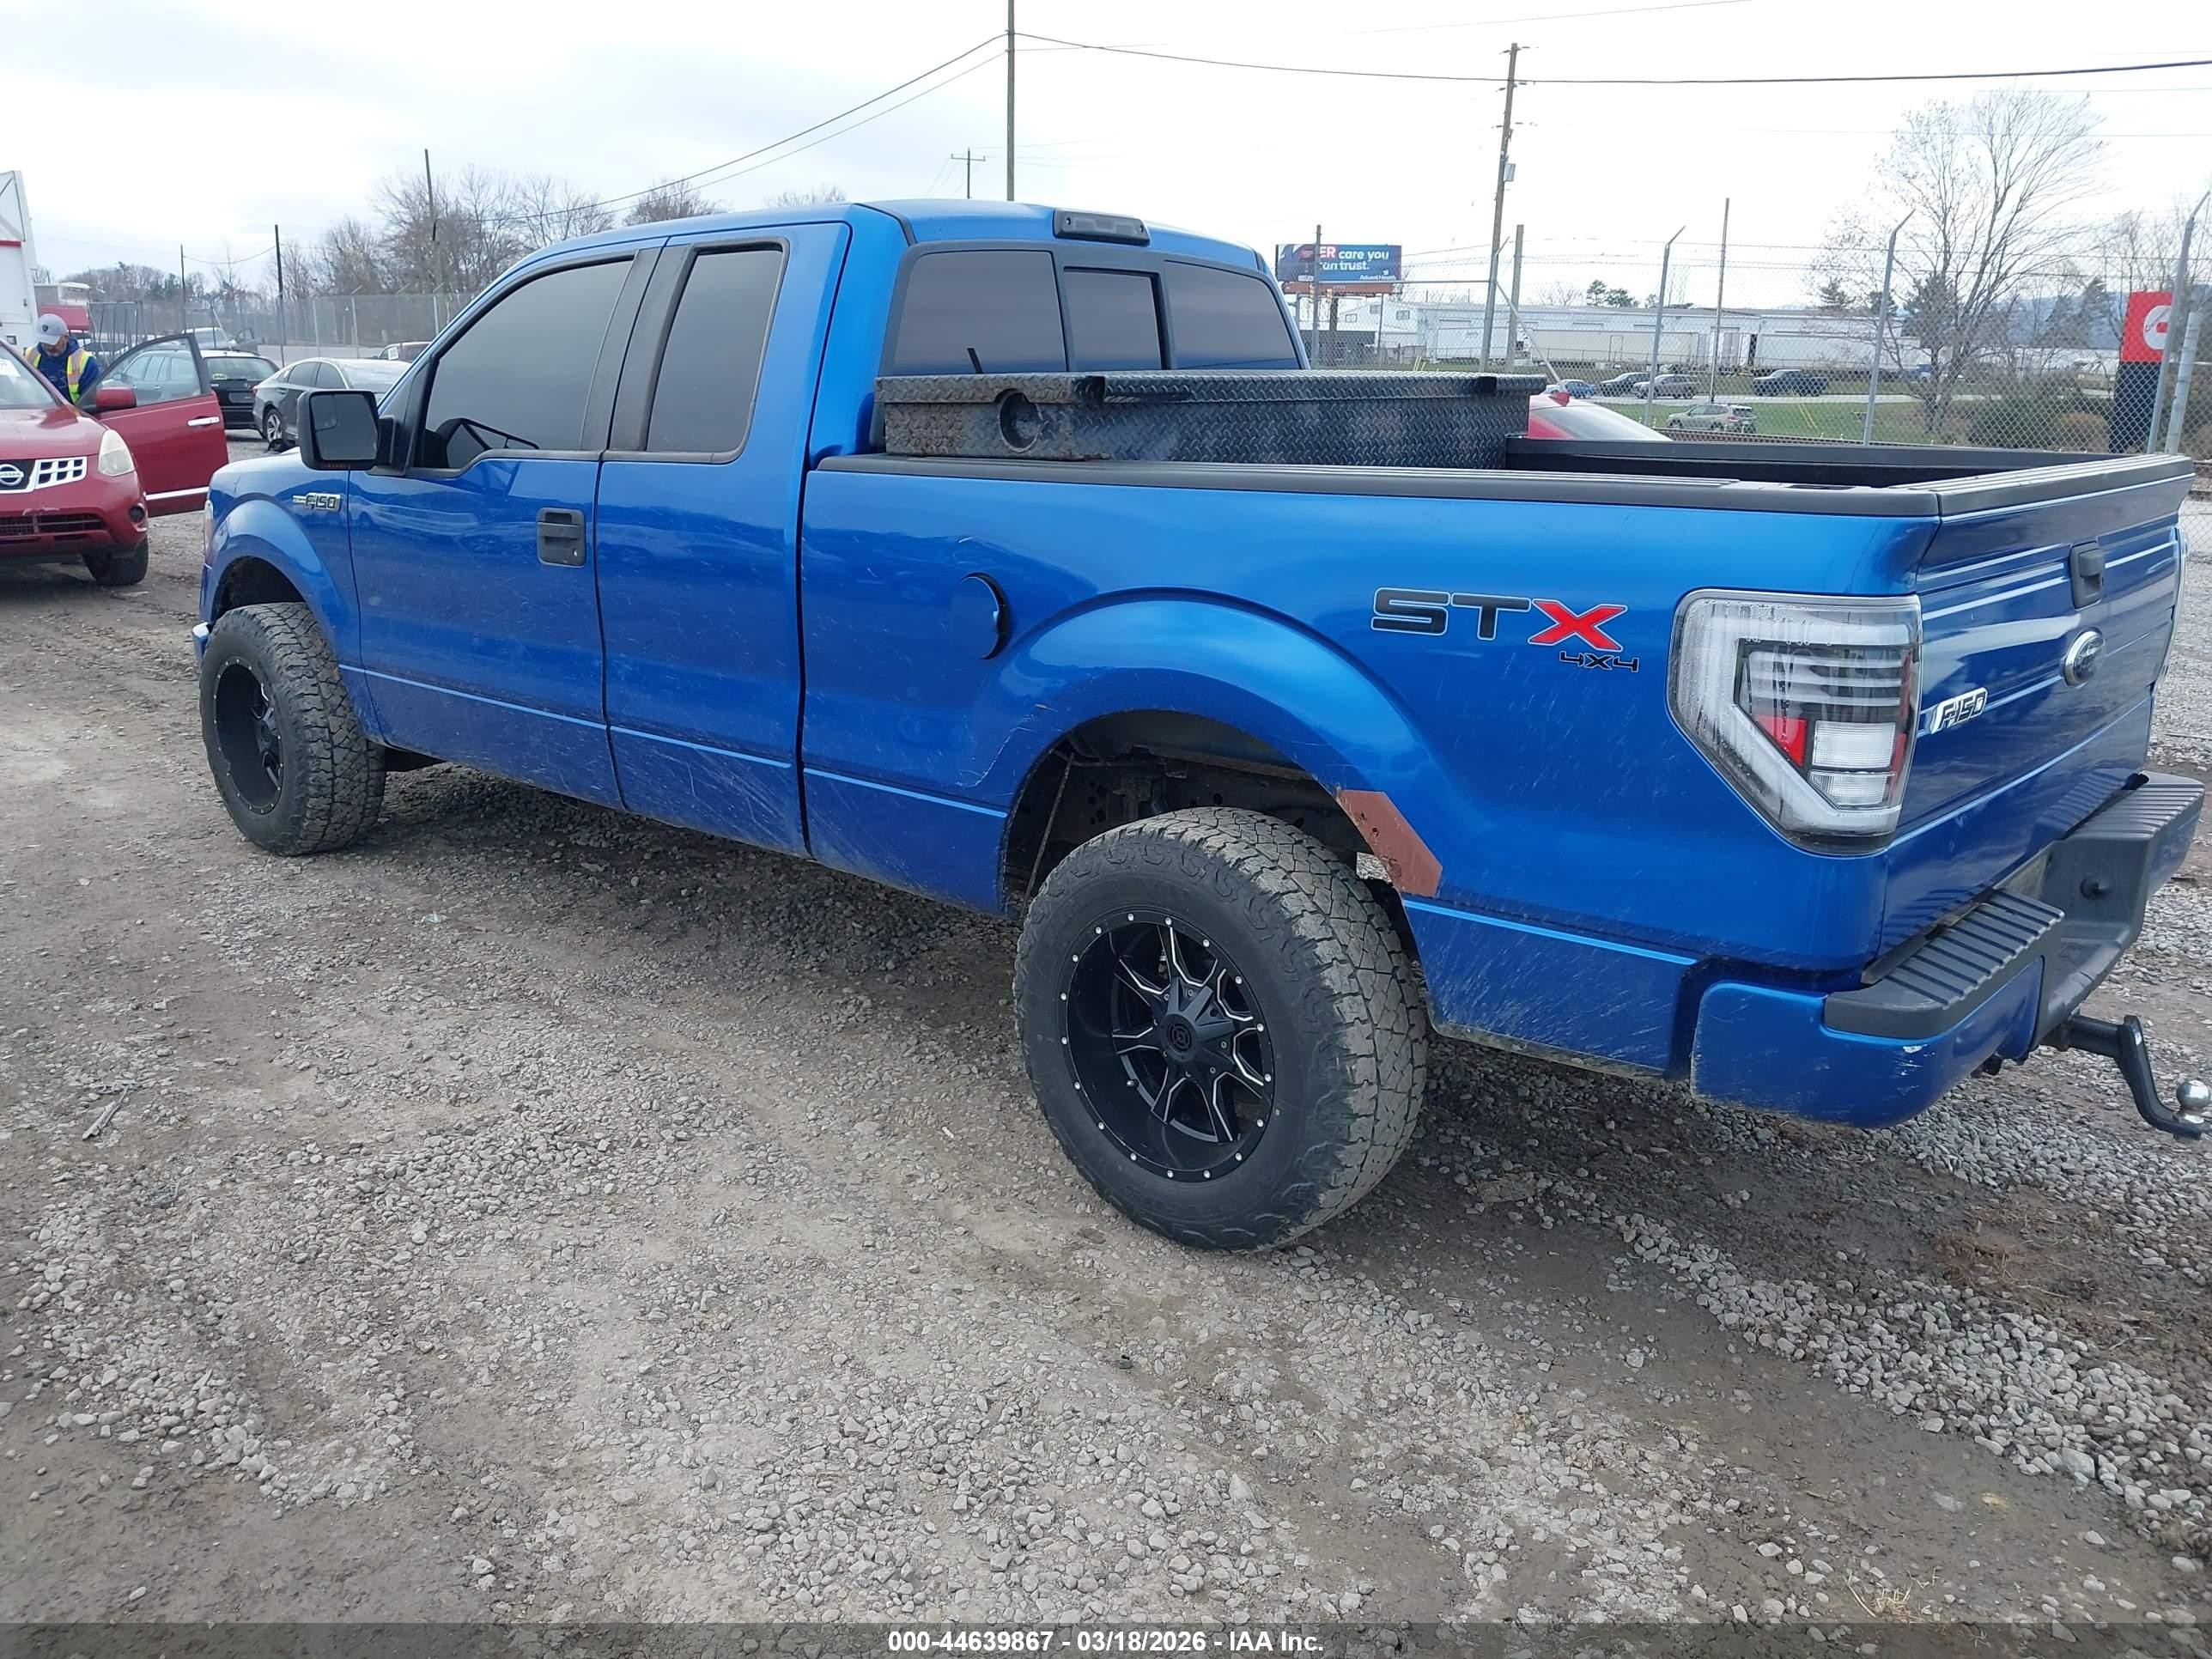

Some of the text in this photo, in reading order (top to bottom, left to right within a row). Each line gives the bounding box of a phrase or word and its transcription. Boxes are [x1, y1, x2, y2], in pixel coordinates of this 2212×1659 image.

[1320, 246, 1389, 263] ER care you
[1320, 261, 1370, 271] an trust.
[1370, 587, 1628, 653] STX
